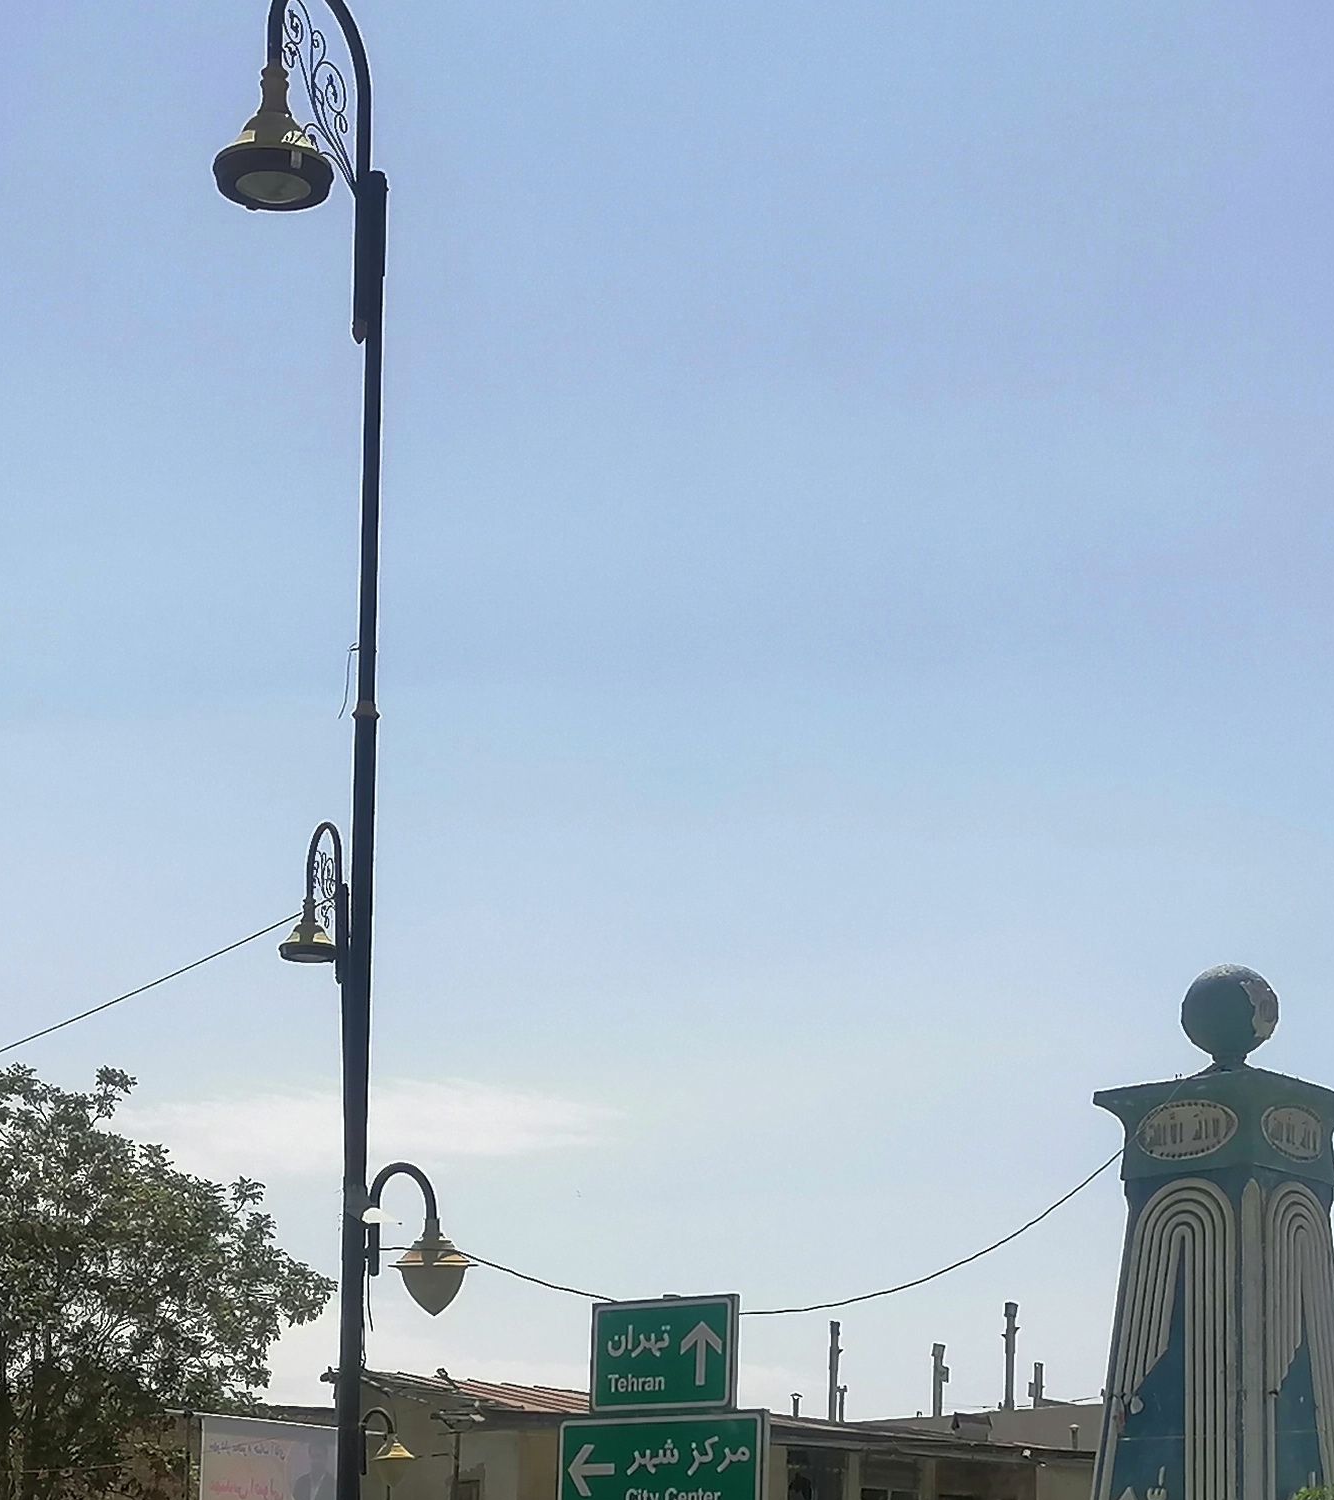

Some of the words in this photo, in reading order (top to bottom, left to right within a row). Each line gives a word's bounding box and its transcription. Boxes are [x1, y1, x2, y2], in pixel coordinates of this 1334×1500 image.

[607, 1324, 671, 1358] تهران
[607, 1374, 665, 1393] Tehran
[626, 1439, 679, 1476] شهر
[688, 1436, 751, 1476] مرکز
